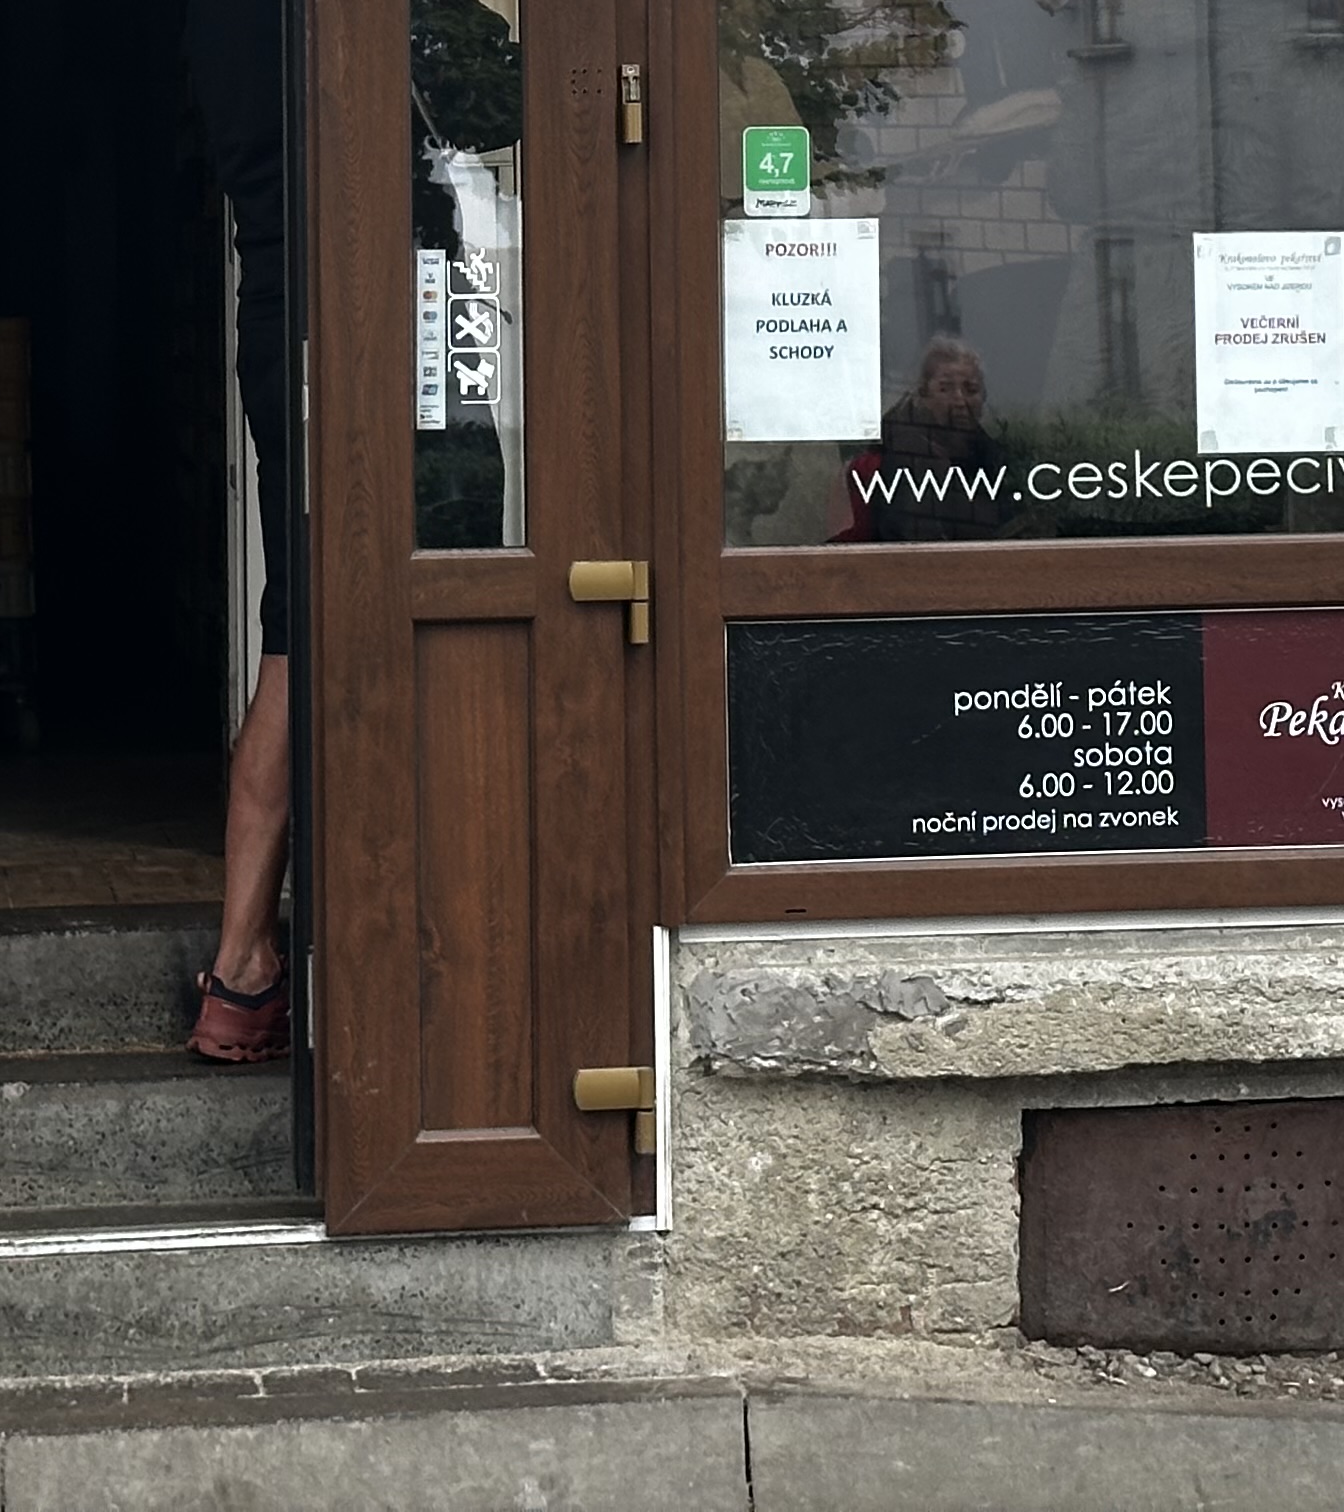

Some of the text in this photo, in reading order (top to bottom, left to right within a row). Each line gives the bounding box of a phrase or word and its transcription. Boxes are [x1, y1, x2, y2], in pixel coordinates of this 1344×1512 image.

[759, 152, 794, 178] 4,7
[765, 243, 837, 257] POZOR!!!
[771, 288, 832, 306] KLUZKÁ
[756, 319, 848, 333] PODLAHA A
[1240, 314, 1299, 329] VEČERNÍ
[1215, 330, 1326, 345] PRODEJ ZRUŠEN
[769, 345, 834, 359] SCHODY
[954, 682, 1063, 717] pondělí
[1088, 679, 1172, 712] pátek
[1017, 712, 1074, 739] 6.00
[1103, 710, 1173, 736] 17.00
[1073, 740, 1173, 767] sobota
[1019, 772, 1075, 798] 6.00
[1103, 770, 1175, 796] 12.00
[912, 806, 1179, 836] noční prodej na zvonek
